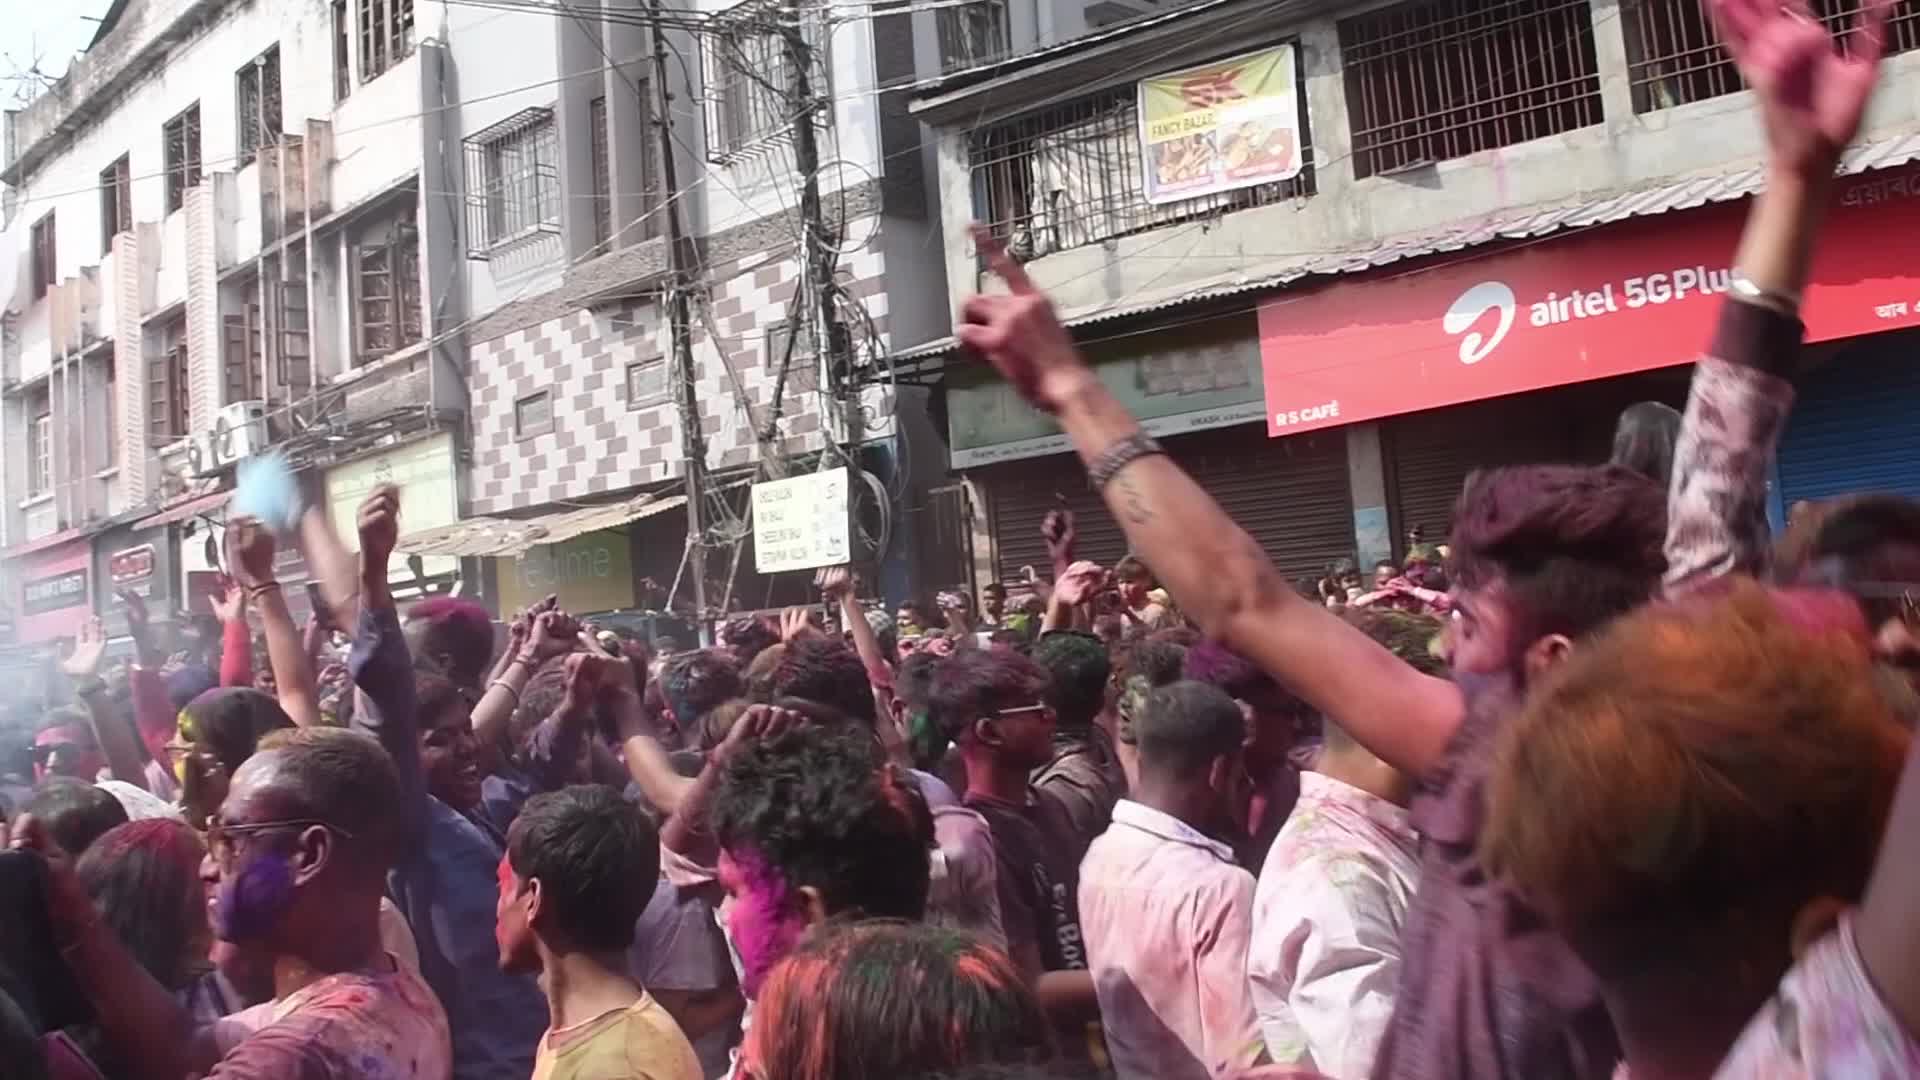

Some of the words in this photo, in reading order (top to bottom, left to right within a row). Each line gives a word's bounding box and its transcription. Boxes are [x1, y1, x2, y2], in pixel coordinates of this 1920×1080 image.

[1151, 121, 1182, 137] FANCY
[1530, 284, 1618, 327] airtel
[1300, 399, 1340, 421] CAFÉ
